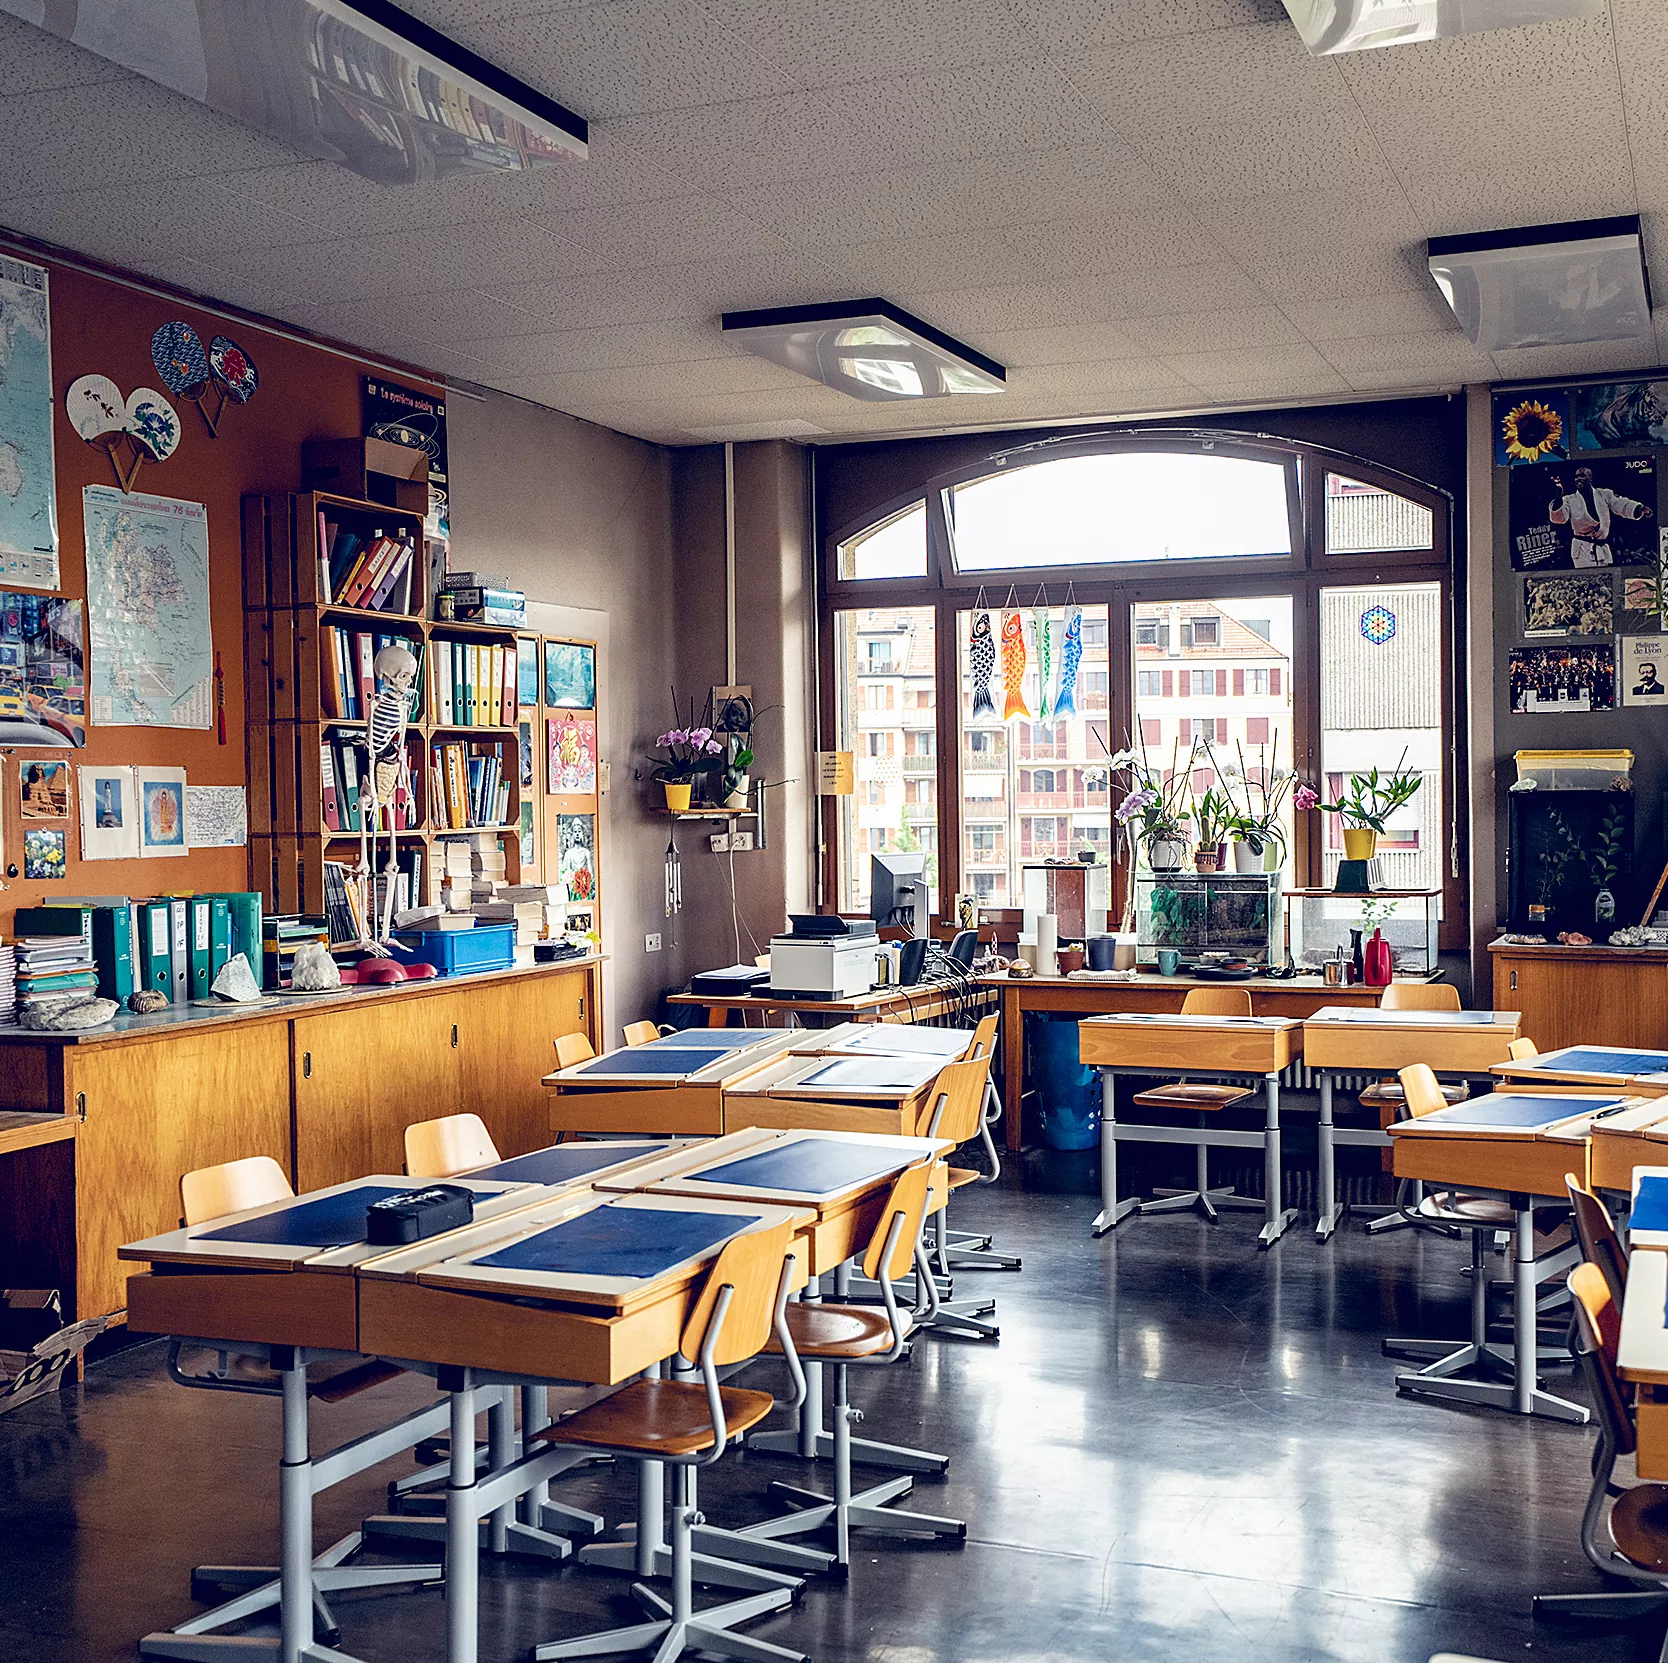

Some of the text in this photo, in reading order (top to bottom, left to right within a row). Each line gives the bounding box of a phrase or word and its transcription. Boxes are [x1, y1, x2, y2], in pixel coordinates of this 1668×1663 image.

[1625, 460, 1648, 469] JUDO
[173, 505, 184, 515] 76
[1528, 524, 1551, 535] Teddy
[1635, 642, 1661, 651] Philippe
[1633, 647, 1662, 656] de Lyon
[560, 727, 581, 766] 福
